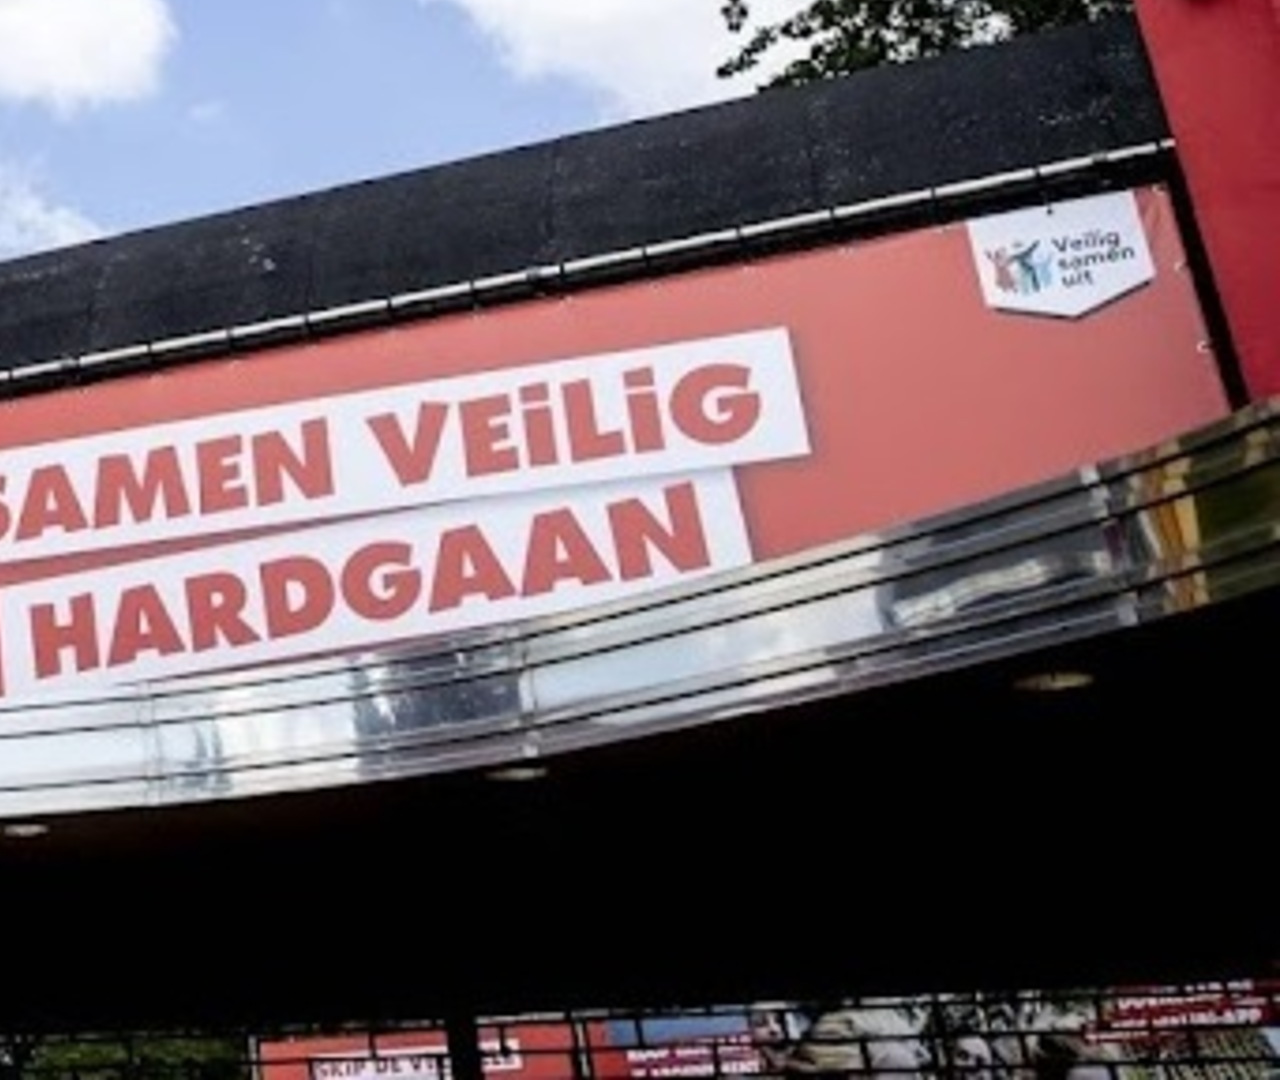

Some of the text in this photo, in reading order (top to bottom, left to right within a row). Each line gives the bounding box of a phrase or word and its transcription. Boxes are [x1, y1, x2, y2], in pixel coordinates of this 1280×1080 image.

[1051, 229, 1119, 253] Veilig
[1058, 246, 1135, 271] samen
[1061, 269, 1094, 288] uit
[29, 482, 709, 678] HARDGAAN
